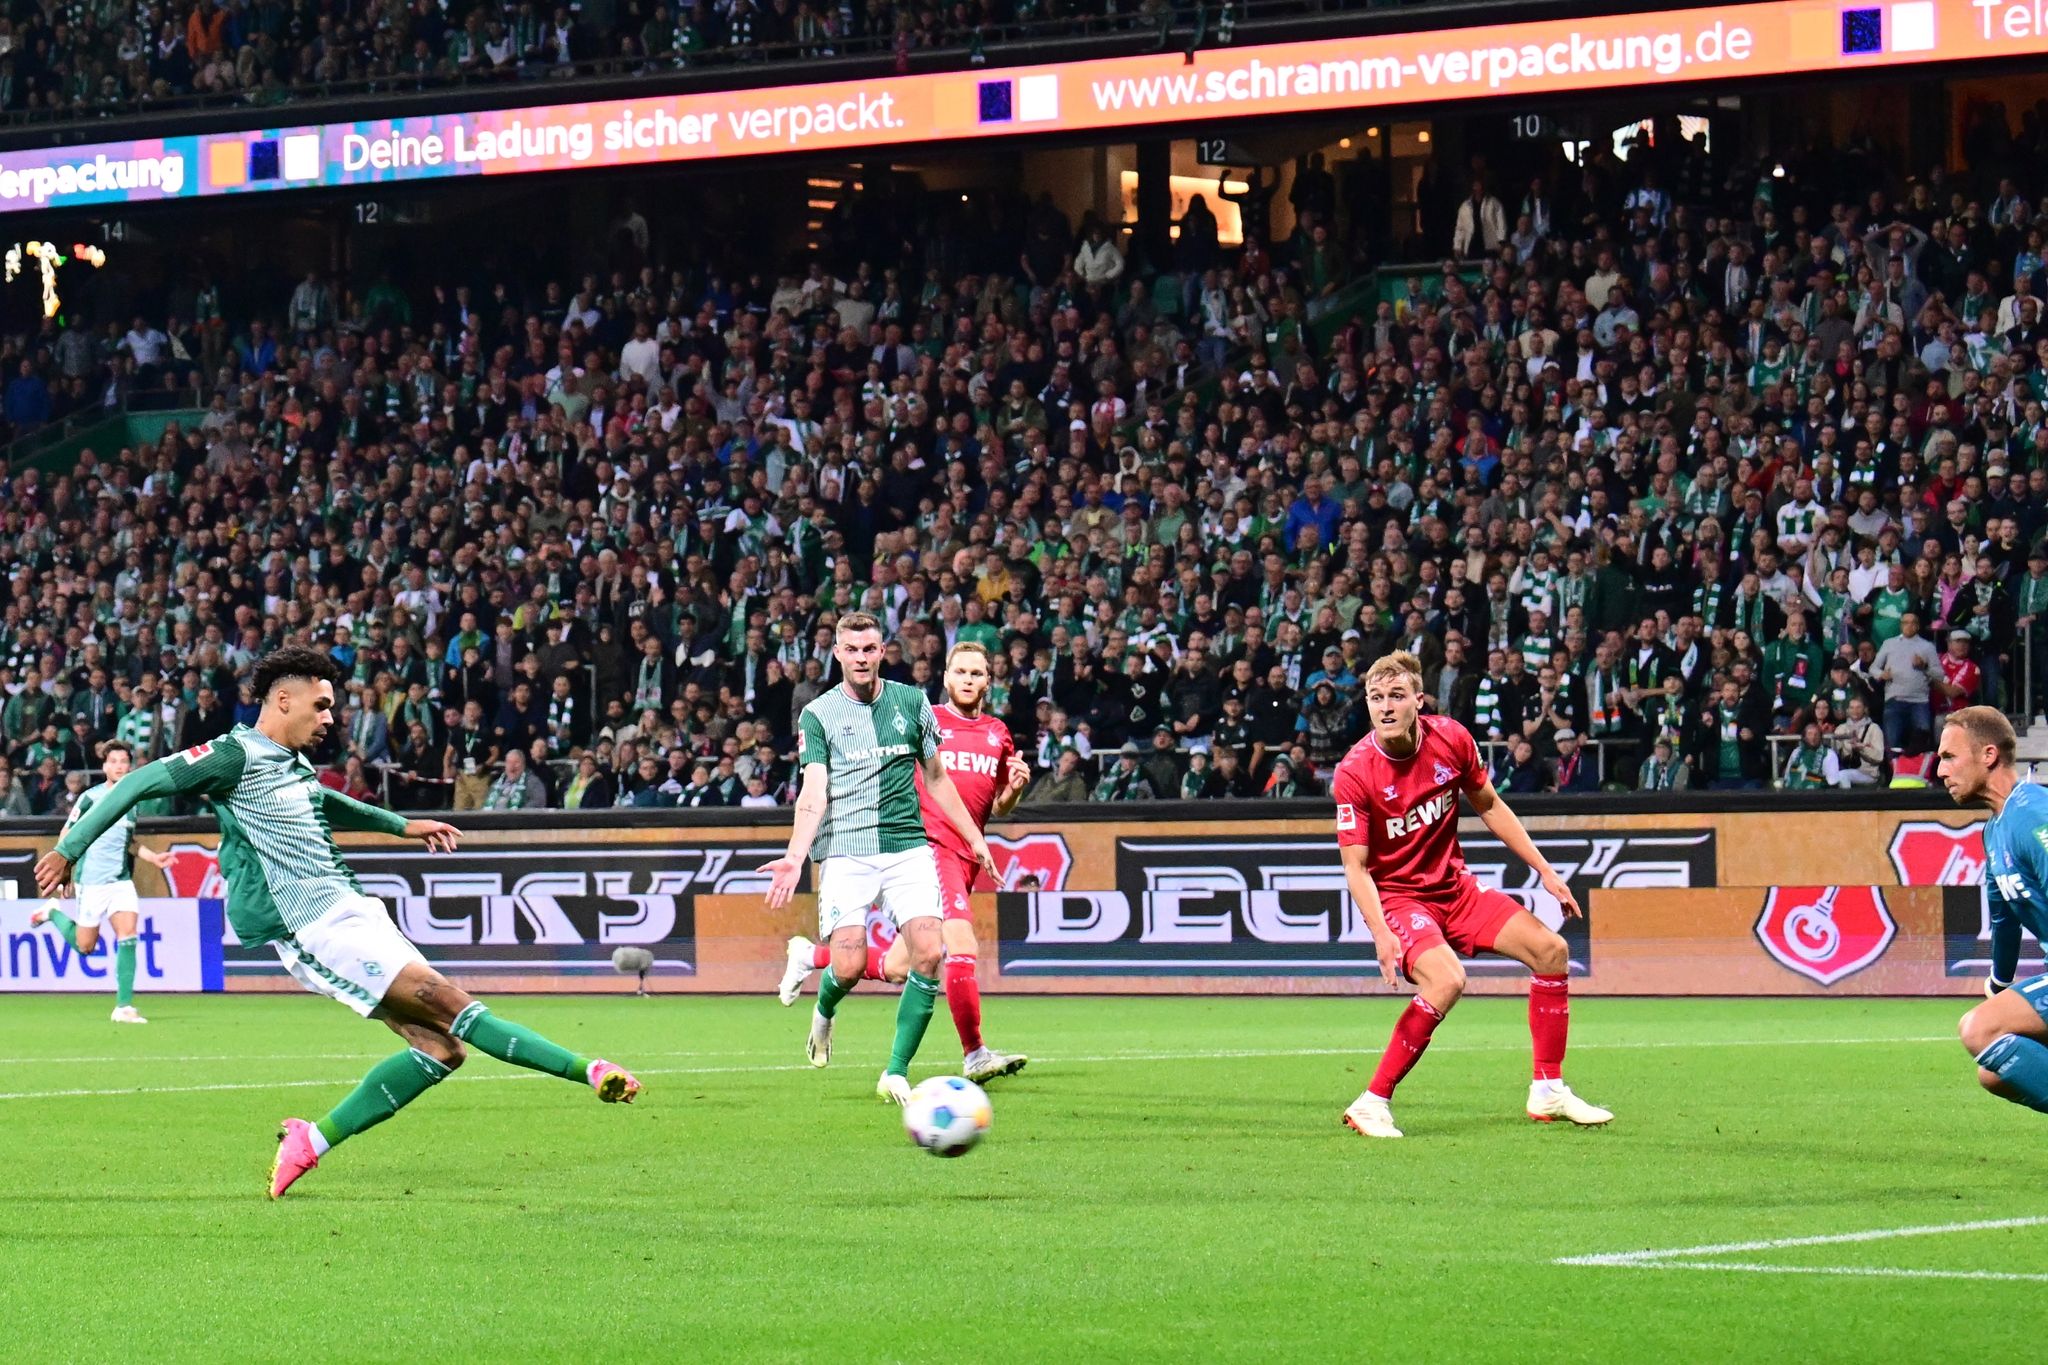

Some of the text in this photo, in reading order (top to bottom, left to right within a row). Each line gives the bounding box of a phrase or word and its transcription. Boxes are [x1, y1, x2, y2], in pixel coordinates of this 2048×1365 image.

[1972, 0, 2048, 40] Tel
[1091, 20, 1753, 111] www.schramm-verpackung.de
[343, 91, 905, 172] Deine Ladung sicher verpackt.
[1513, 115, 1539, 138] 10
[1200, 139, 1225, 162] 12
[0, 154, 184, 204] erpackung
[101, 221, 122, 242] 14
[355, 202, 378, 223] 12
[940, 751, 999, 778] REWE
[1385, 788, 1454, 841] REWE
[0, 916, 164, 979] nvet
